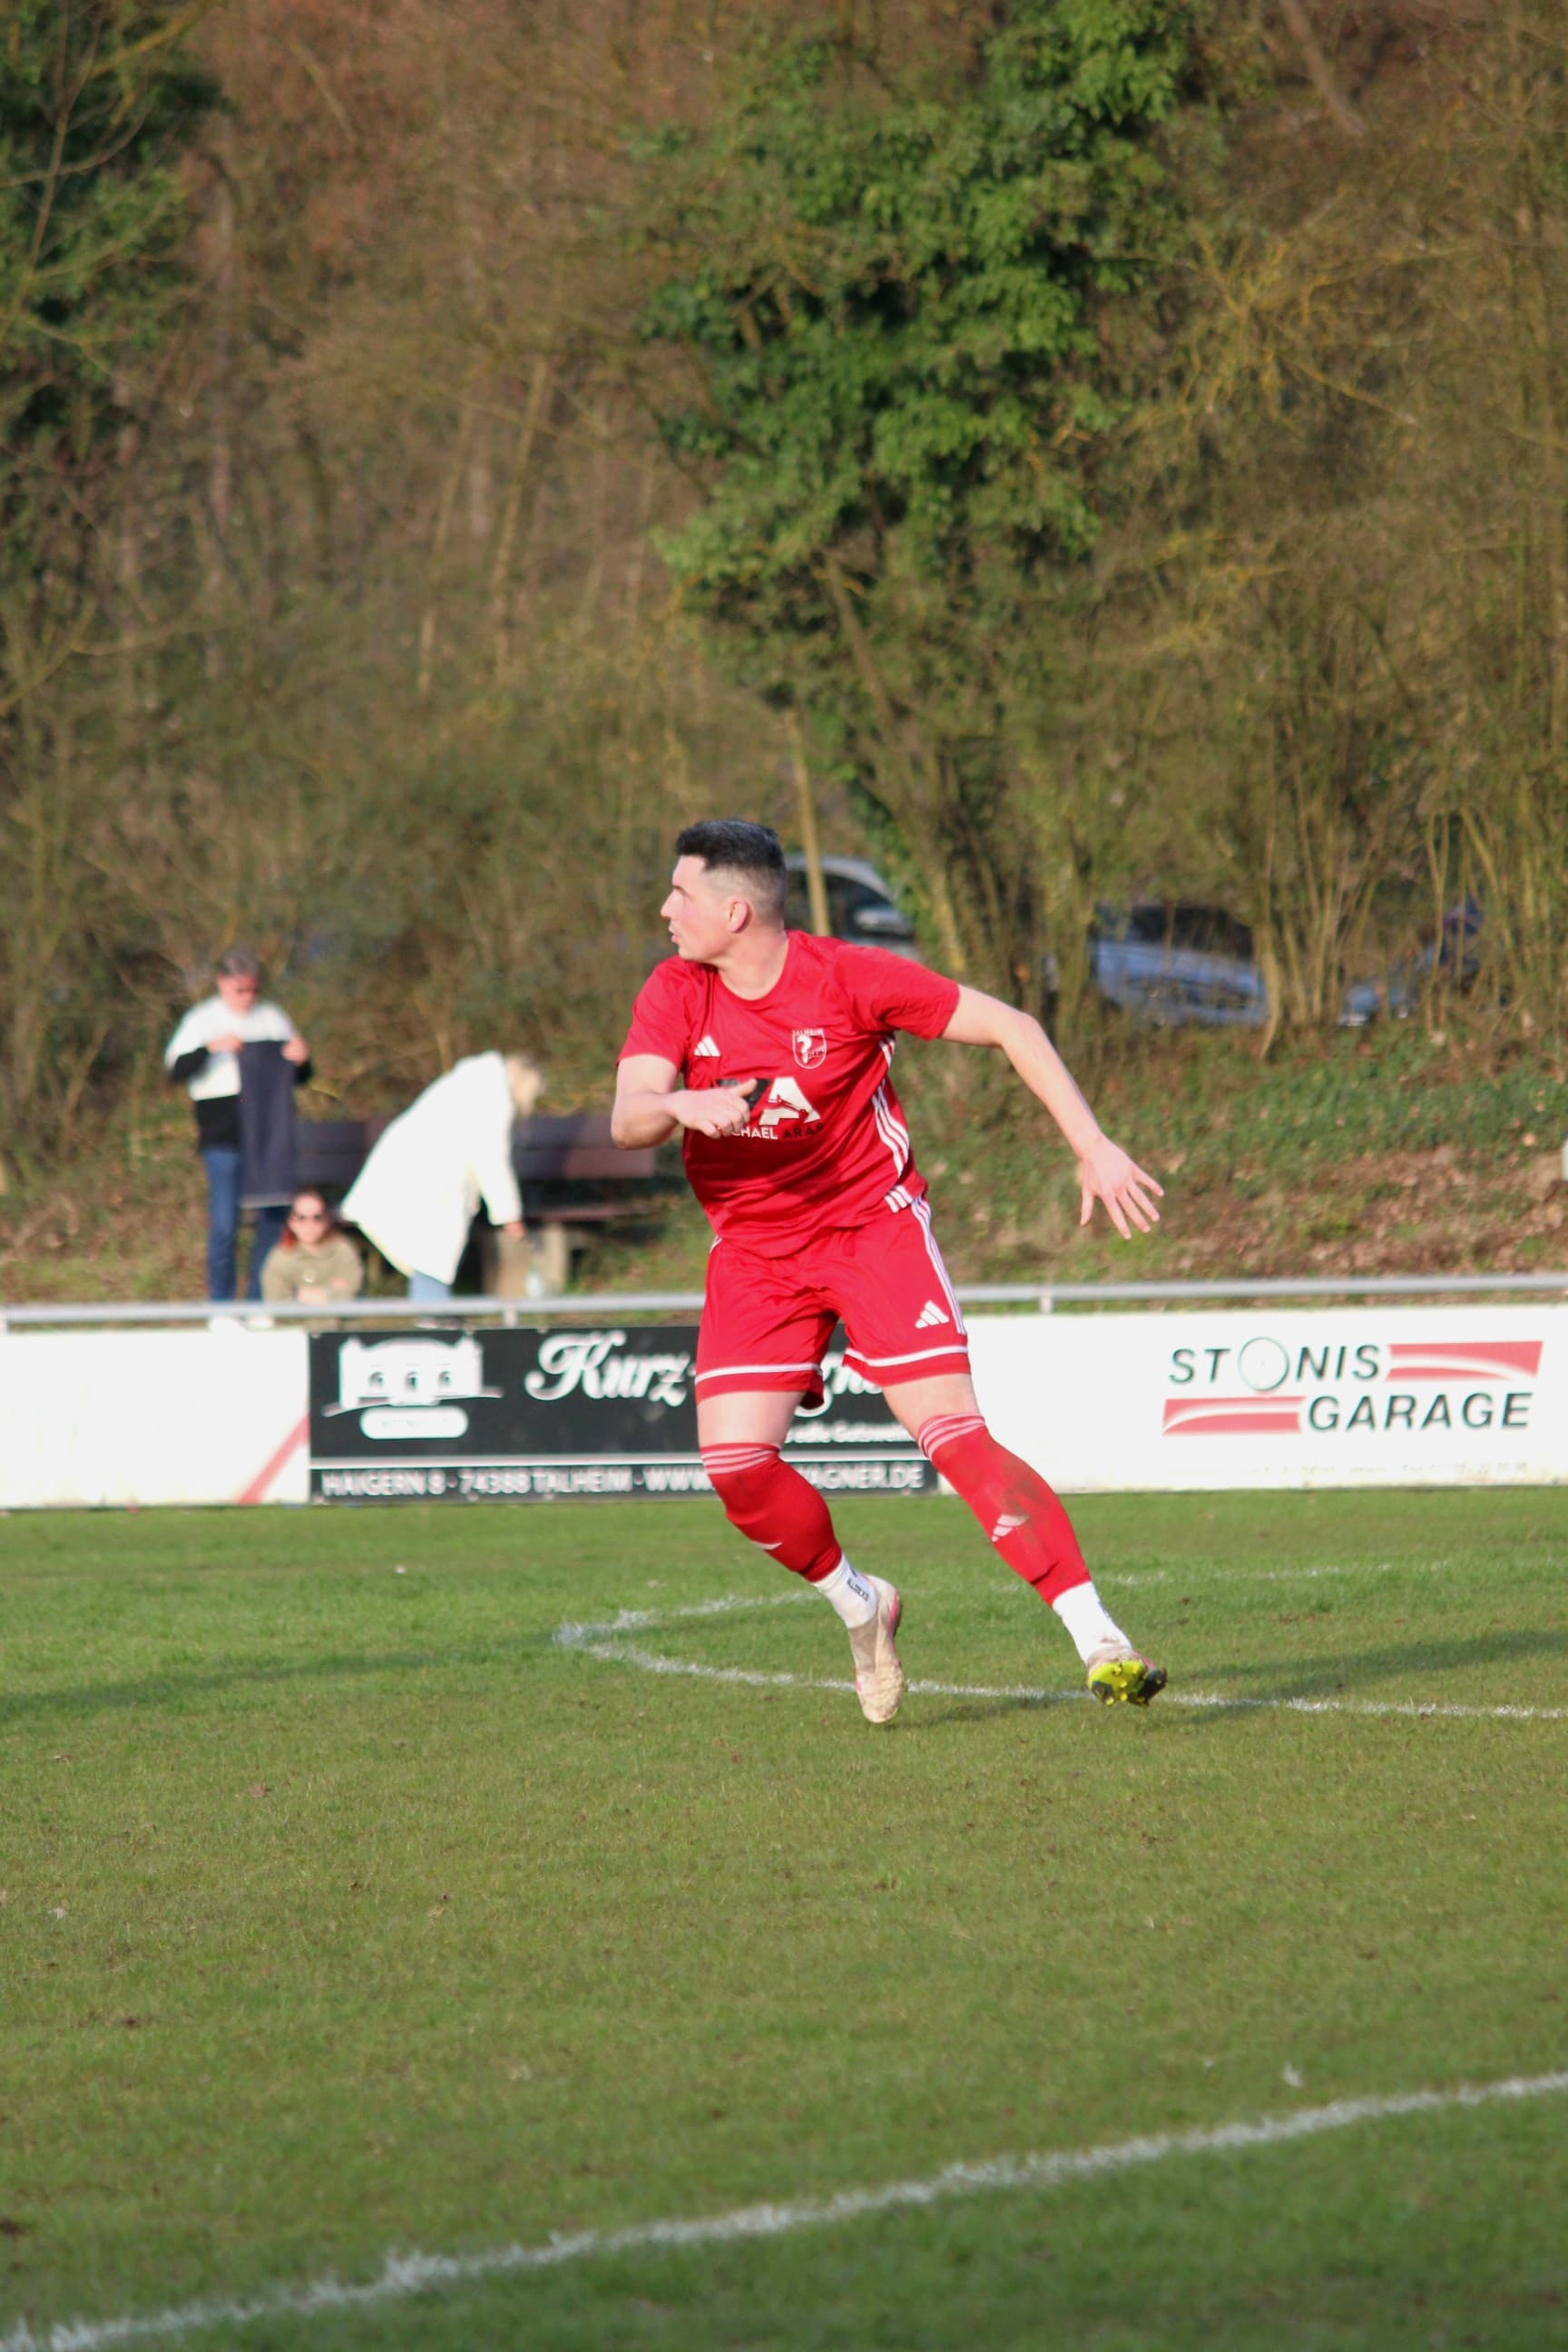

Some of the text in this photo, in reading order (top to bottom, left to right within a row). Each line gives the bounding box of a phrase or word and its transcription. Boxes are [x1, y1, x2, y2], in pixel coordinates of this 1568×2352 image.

[732, 1126, 779, 1140] HAEL
[1168, 1337, 1381, 1392] STONIS
[1308, 1392, 1534, 1432] GARAGE
[321, 1469, 426, 1496] HAIGERN
[457, 1467, 531, 1495] 74388
[532, 1466, 633, 1494] TALHEIM
